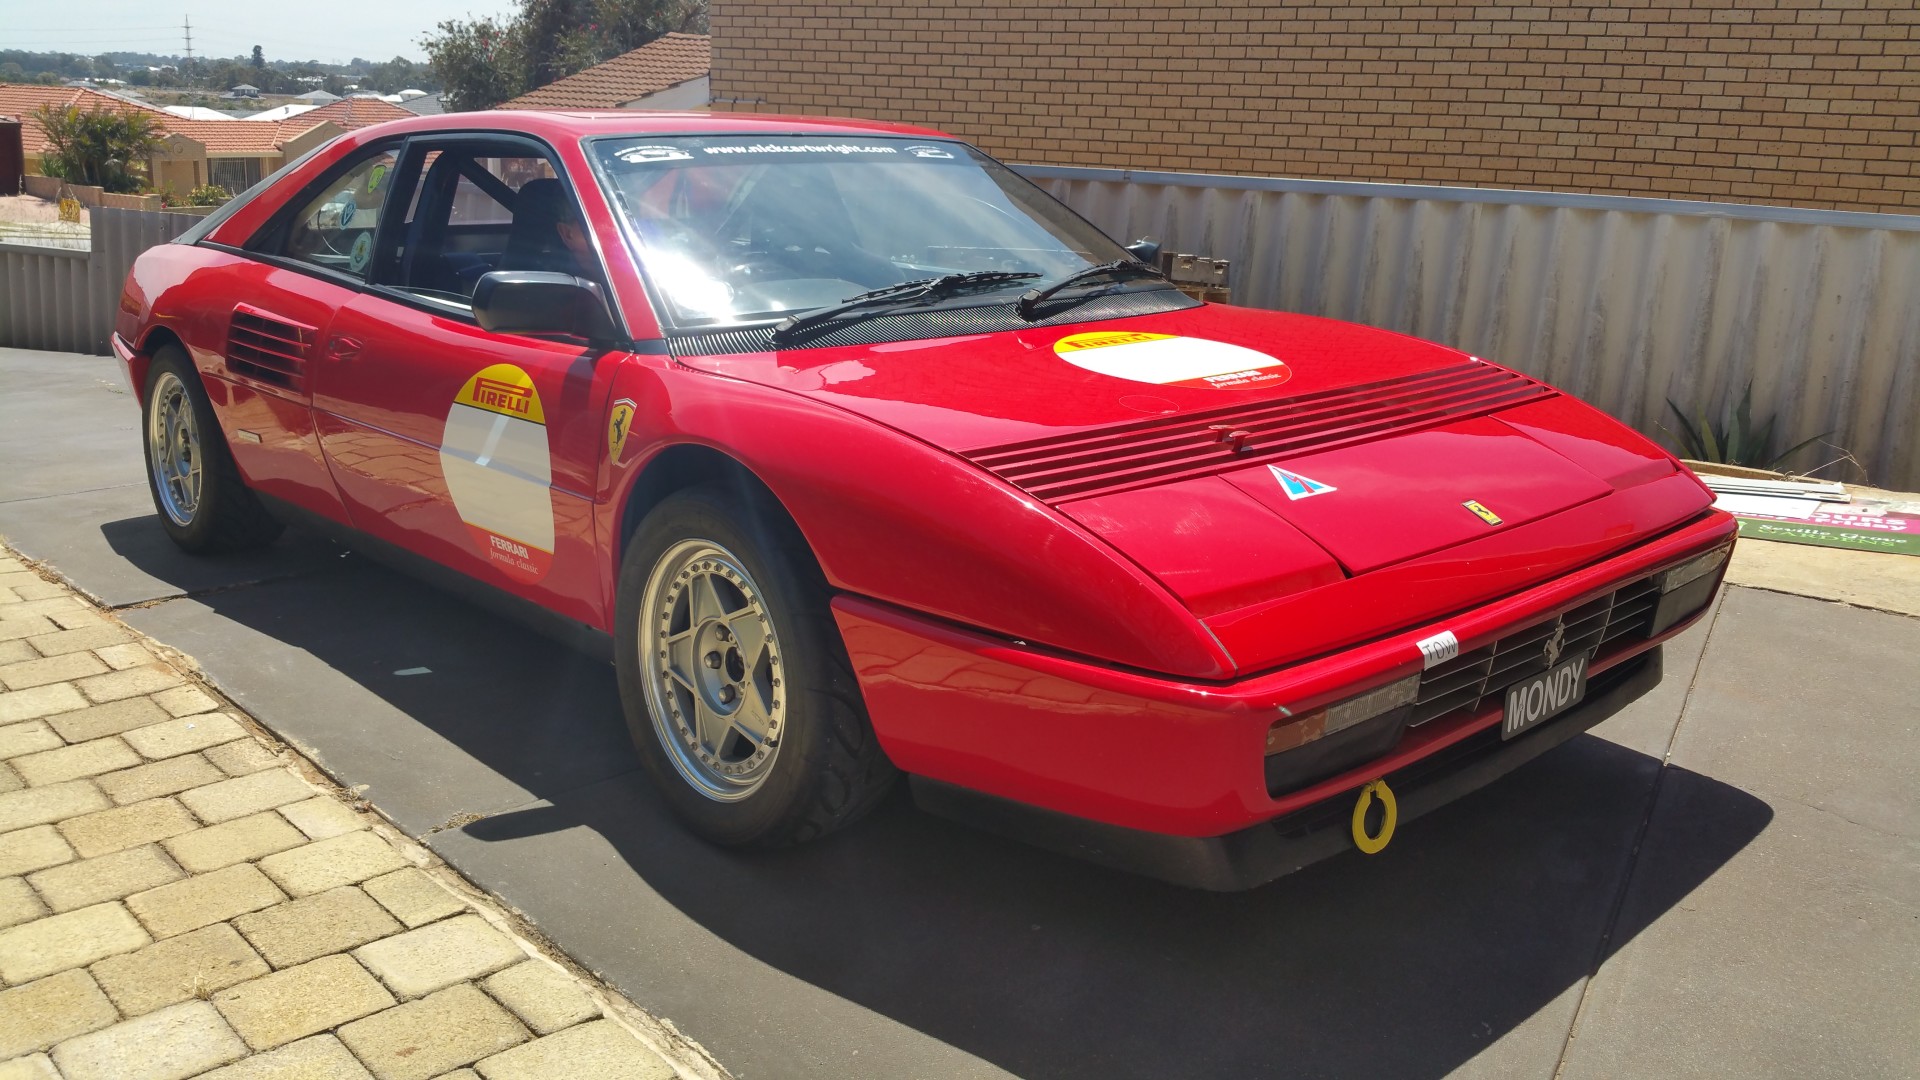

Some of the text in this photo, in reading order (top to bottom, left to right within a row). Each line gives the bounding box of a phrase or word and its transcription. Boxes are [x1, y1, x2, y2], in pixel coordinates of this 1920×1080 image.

[703, 144, 897, 154] www.nickcartwright.com
[1063, 333, 1152, 349] PIRELLI
[473, 377, 533, 414] PIRELLI
[1760, 524, 1907, 543] Seville Grove
[1814, 518, 1908, 531] Friday
[489, 535, 529, 560] FERRARI
[489, 547, 539, 575] formula classic
[1422, 637, 1457, 661] TOW
[1507, 658, 1585, 733] MONDY
